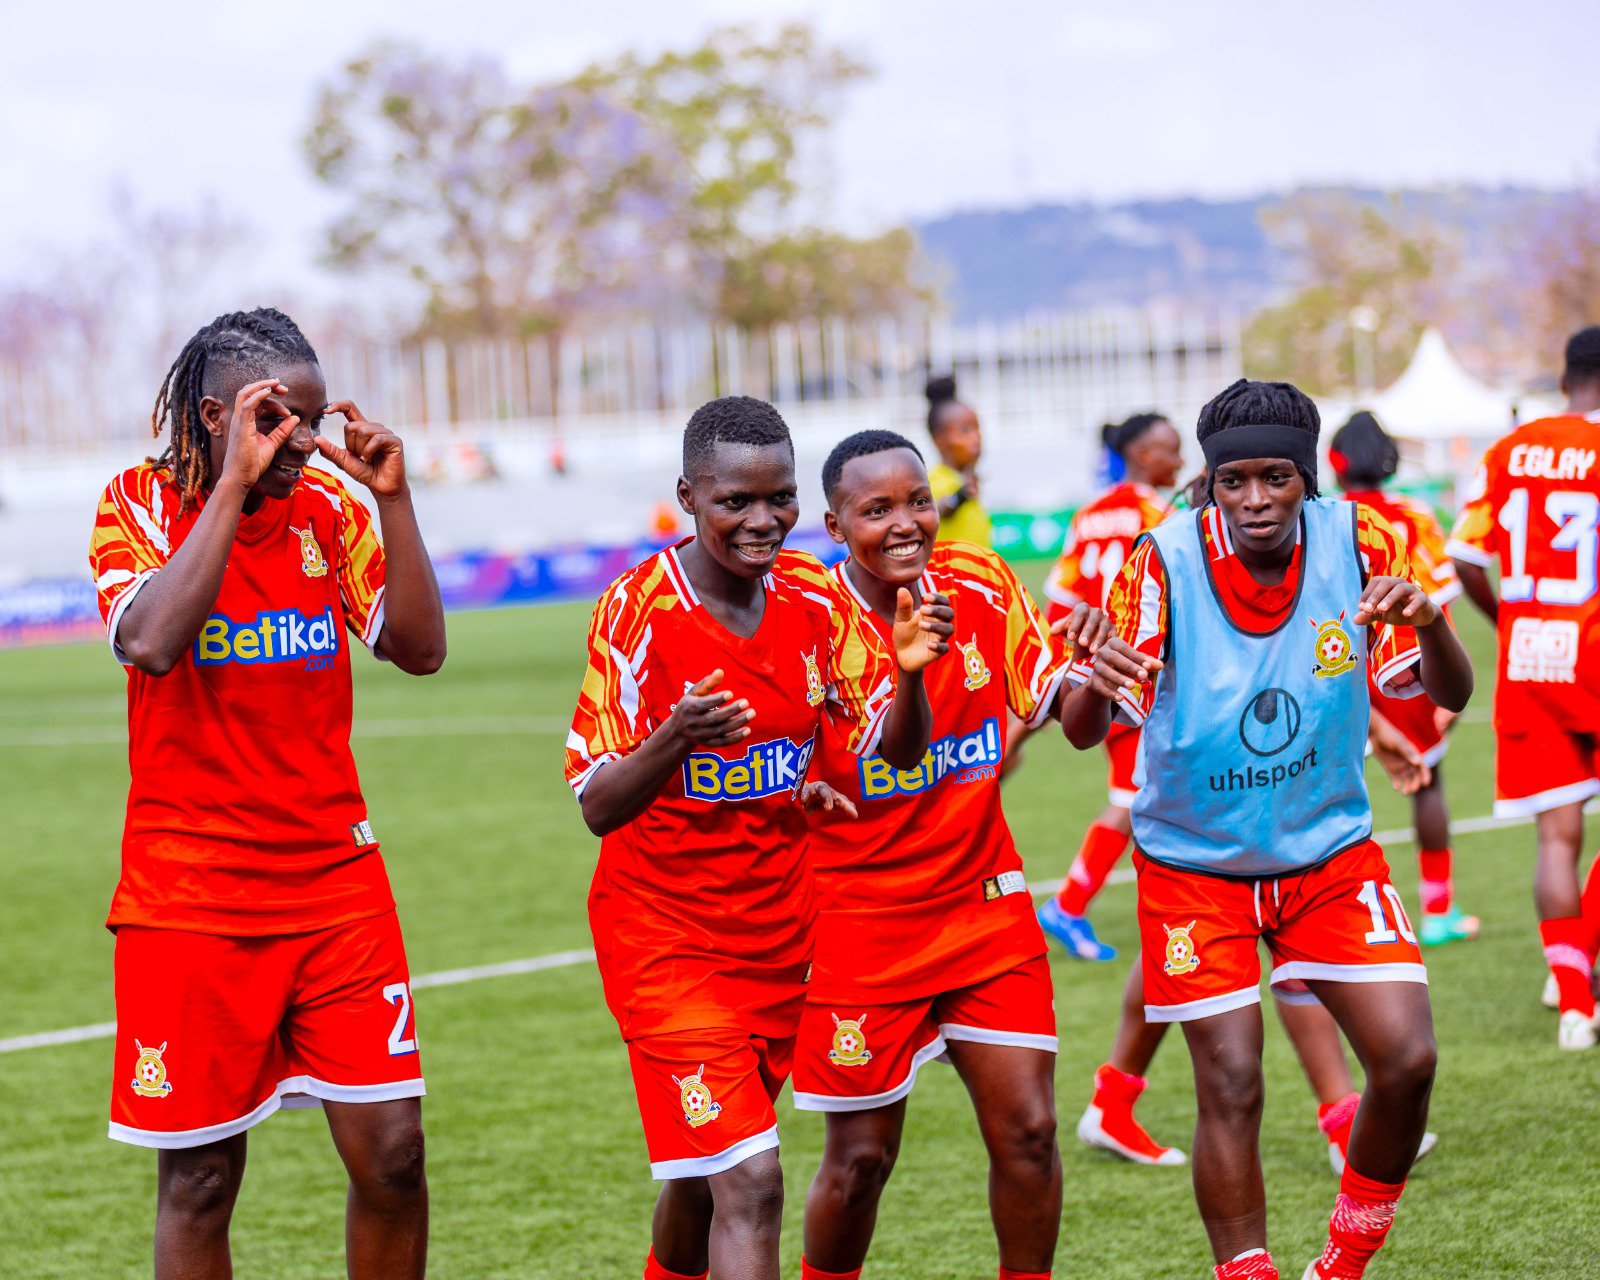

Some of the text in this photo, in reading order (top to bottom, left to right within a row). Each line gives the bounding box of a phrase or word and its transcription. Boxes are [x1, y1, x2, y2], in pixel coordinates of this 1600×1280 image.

[1508, 444, 1596, 481] EGLAY
[1498, 487, 1600, 605] 13
[199, 611, 336, 660] Betika!
[304, 657, 335, 672] .com
[689, 744, 813, 795] Betika
[862, 722, 997, 796] Betika!
[954, 766, 996, 785] .com
[1209, 747, 1317, 791] uhlsport
[1356, 879, 1418, 946] 10
[383, 982, 419, 1056] 2
